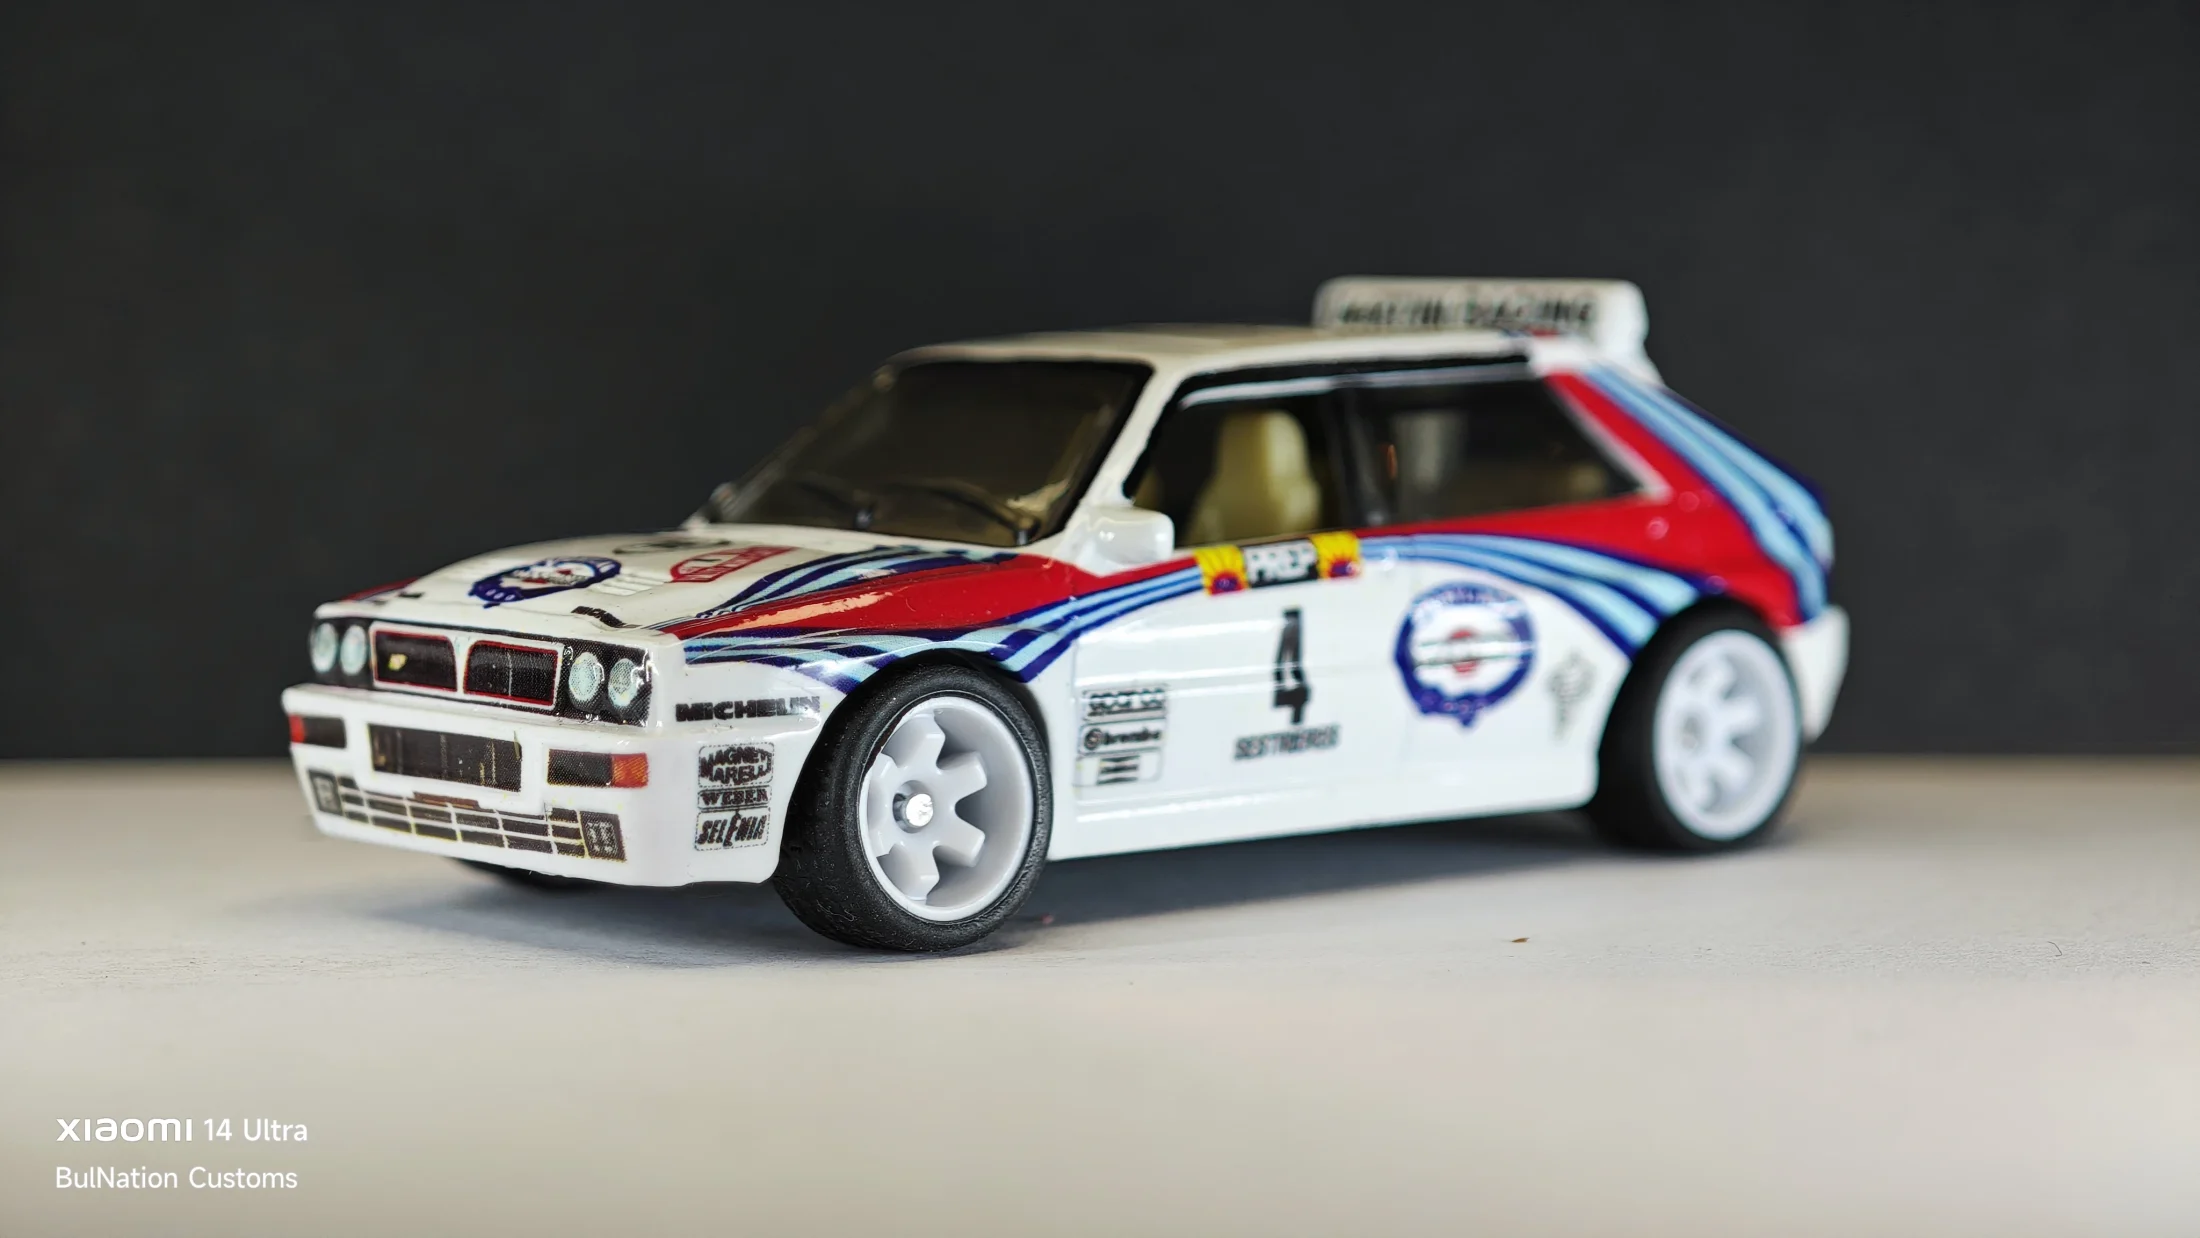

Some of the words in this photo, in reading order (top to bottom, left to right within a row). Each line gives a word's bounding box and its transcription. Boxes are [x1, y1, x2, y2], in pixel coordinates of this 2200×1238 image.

[1244, 541, 1316, 585] PREP
[1272, 606, 1312, 724] 4
[675, 696, 820, 722] MICHELIN
